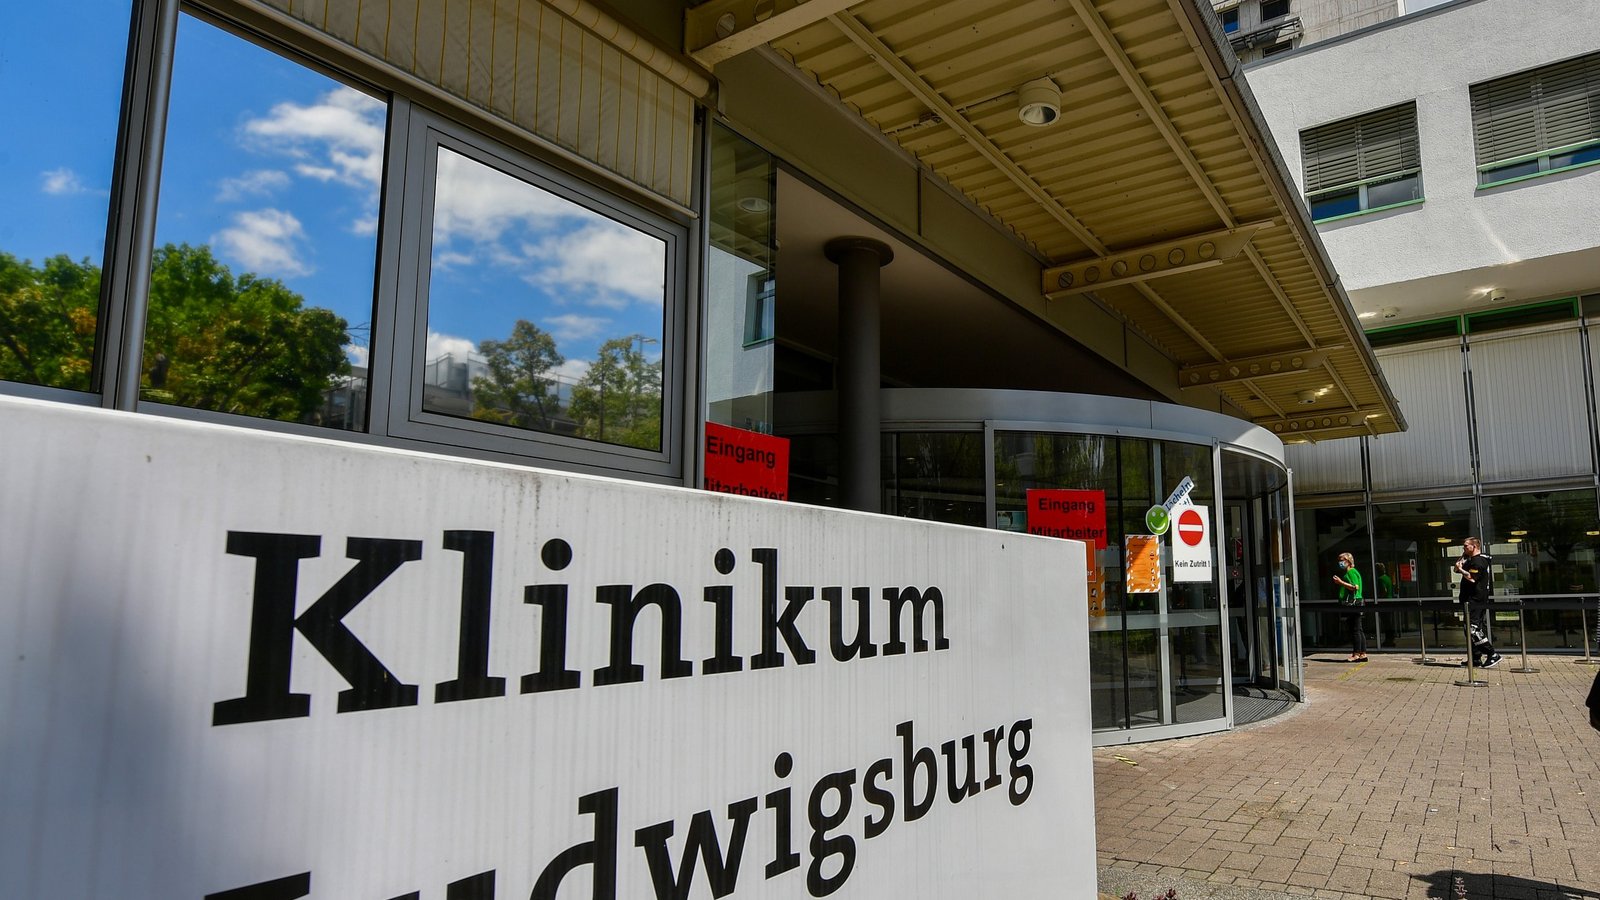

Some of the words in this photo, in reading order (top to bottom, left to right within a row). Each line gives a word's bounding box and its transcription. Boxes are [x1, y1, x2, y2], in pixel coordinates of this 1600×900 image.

[706, 436, 776, 469] Eingang
[1038, 498, 1096, 513] Eingang
[1174, 559, 1189, 568] Kein
[212, 530, 949, 726] Klinikum
[203, 719, 1034, 900] dwigsburg
